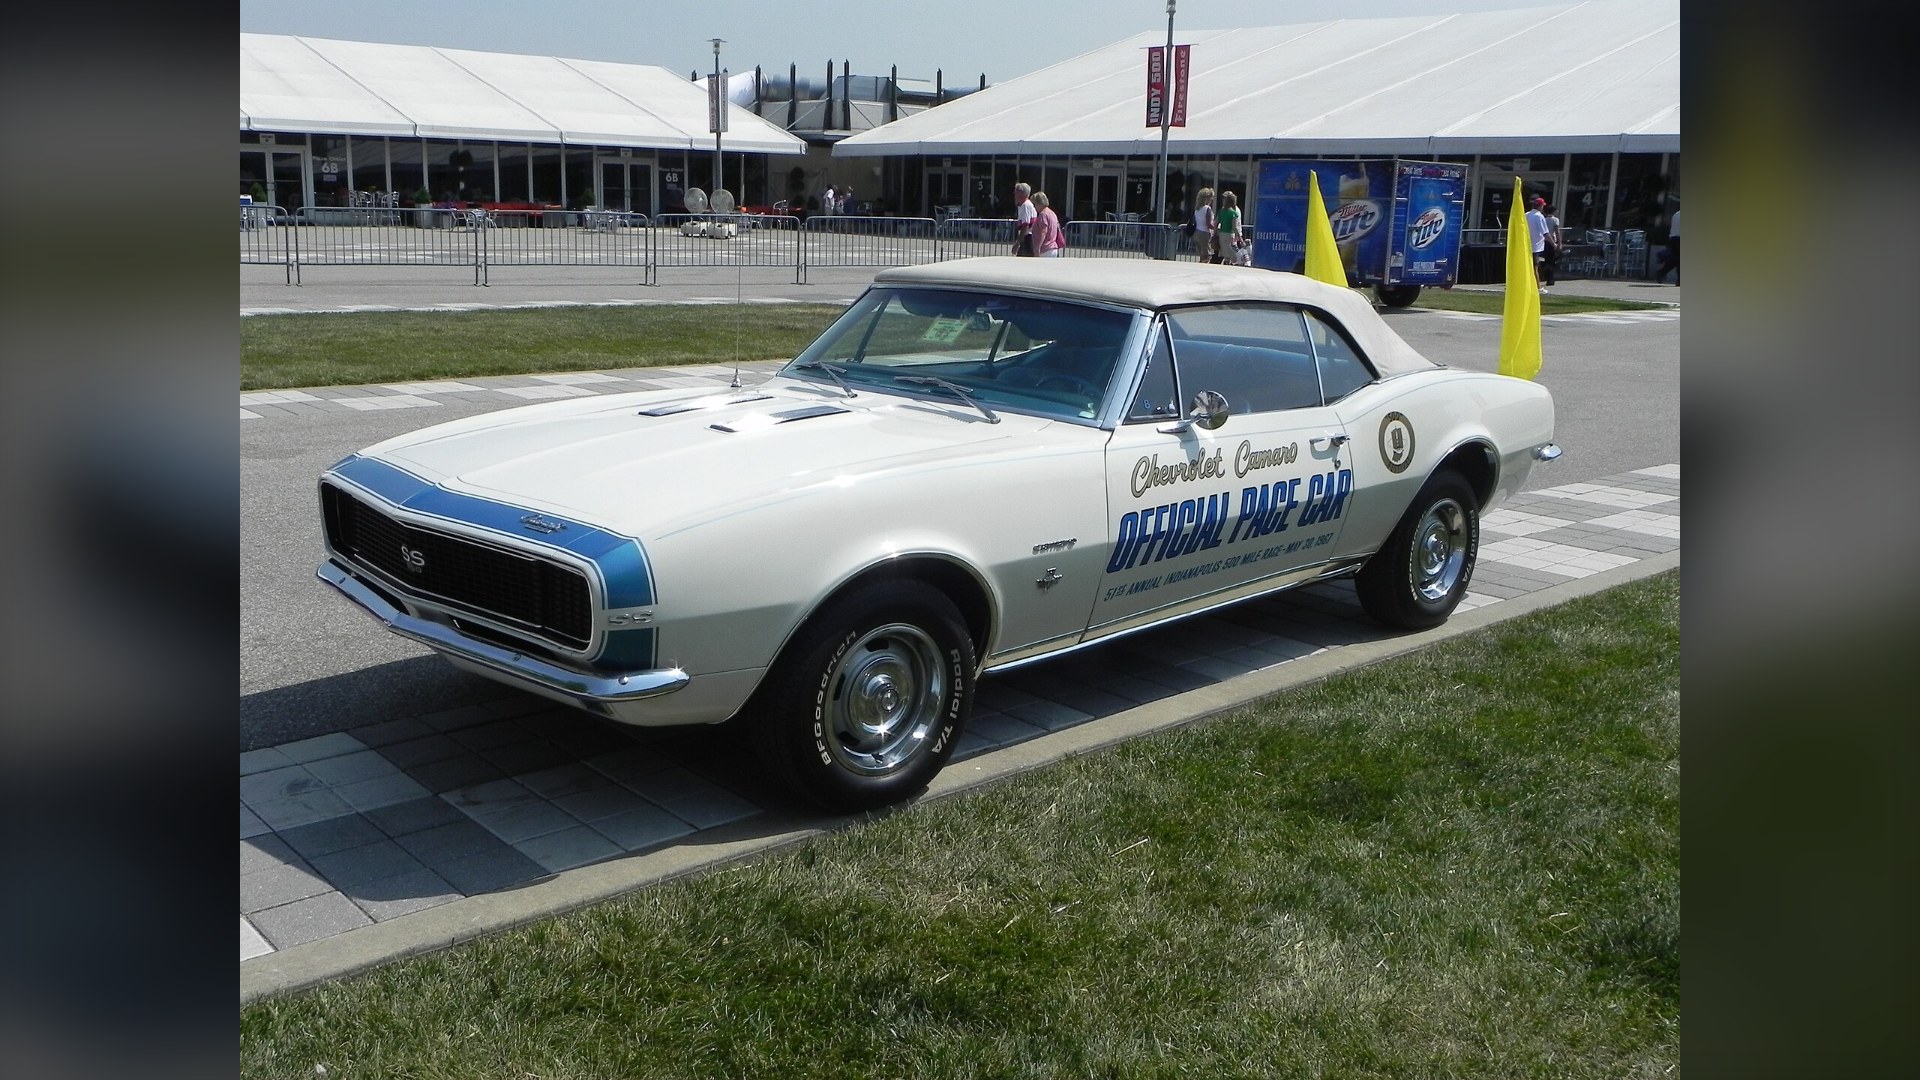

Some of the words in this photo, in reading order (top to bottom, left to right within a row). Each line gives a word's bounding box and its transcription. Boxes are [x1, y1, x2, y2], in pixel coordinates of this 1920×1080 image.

[1151, 51, 1161, 83] 500
[1149, 87, 1161, 124] INDY
[321, 162, 339, 173] 6B
[665, 172, 679, 182] 6B
[977, 180, 984, 191] 5
[1136, 183, 1143, 194] 5
[1582, 192, 1593, 206] 4
[1130, 447, 1225, 498] Chevrolet
[1234, 439, 1298, 479] Camaro
[1106, 491, 1230, 574] OFFICIAL
[1228, 478, 1301, 544] PACE
[1297, 468, 1352, 527] CAR
[401, 545, 425, 566] SS
[1126, 576, 1162, 596] ANNUAL
[1163, 560, 1222, 585] INDIANAPOLIS
[1222, 555, 1241, 570] 500
[1240, 550, 1262, 565] MILE
[814, 630, 856, 766] BFGoodrich
[950, 648, 964, 719] Radial
[931, 725, 954, 755] T/A
